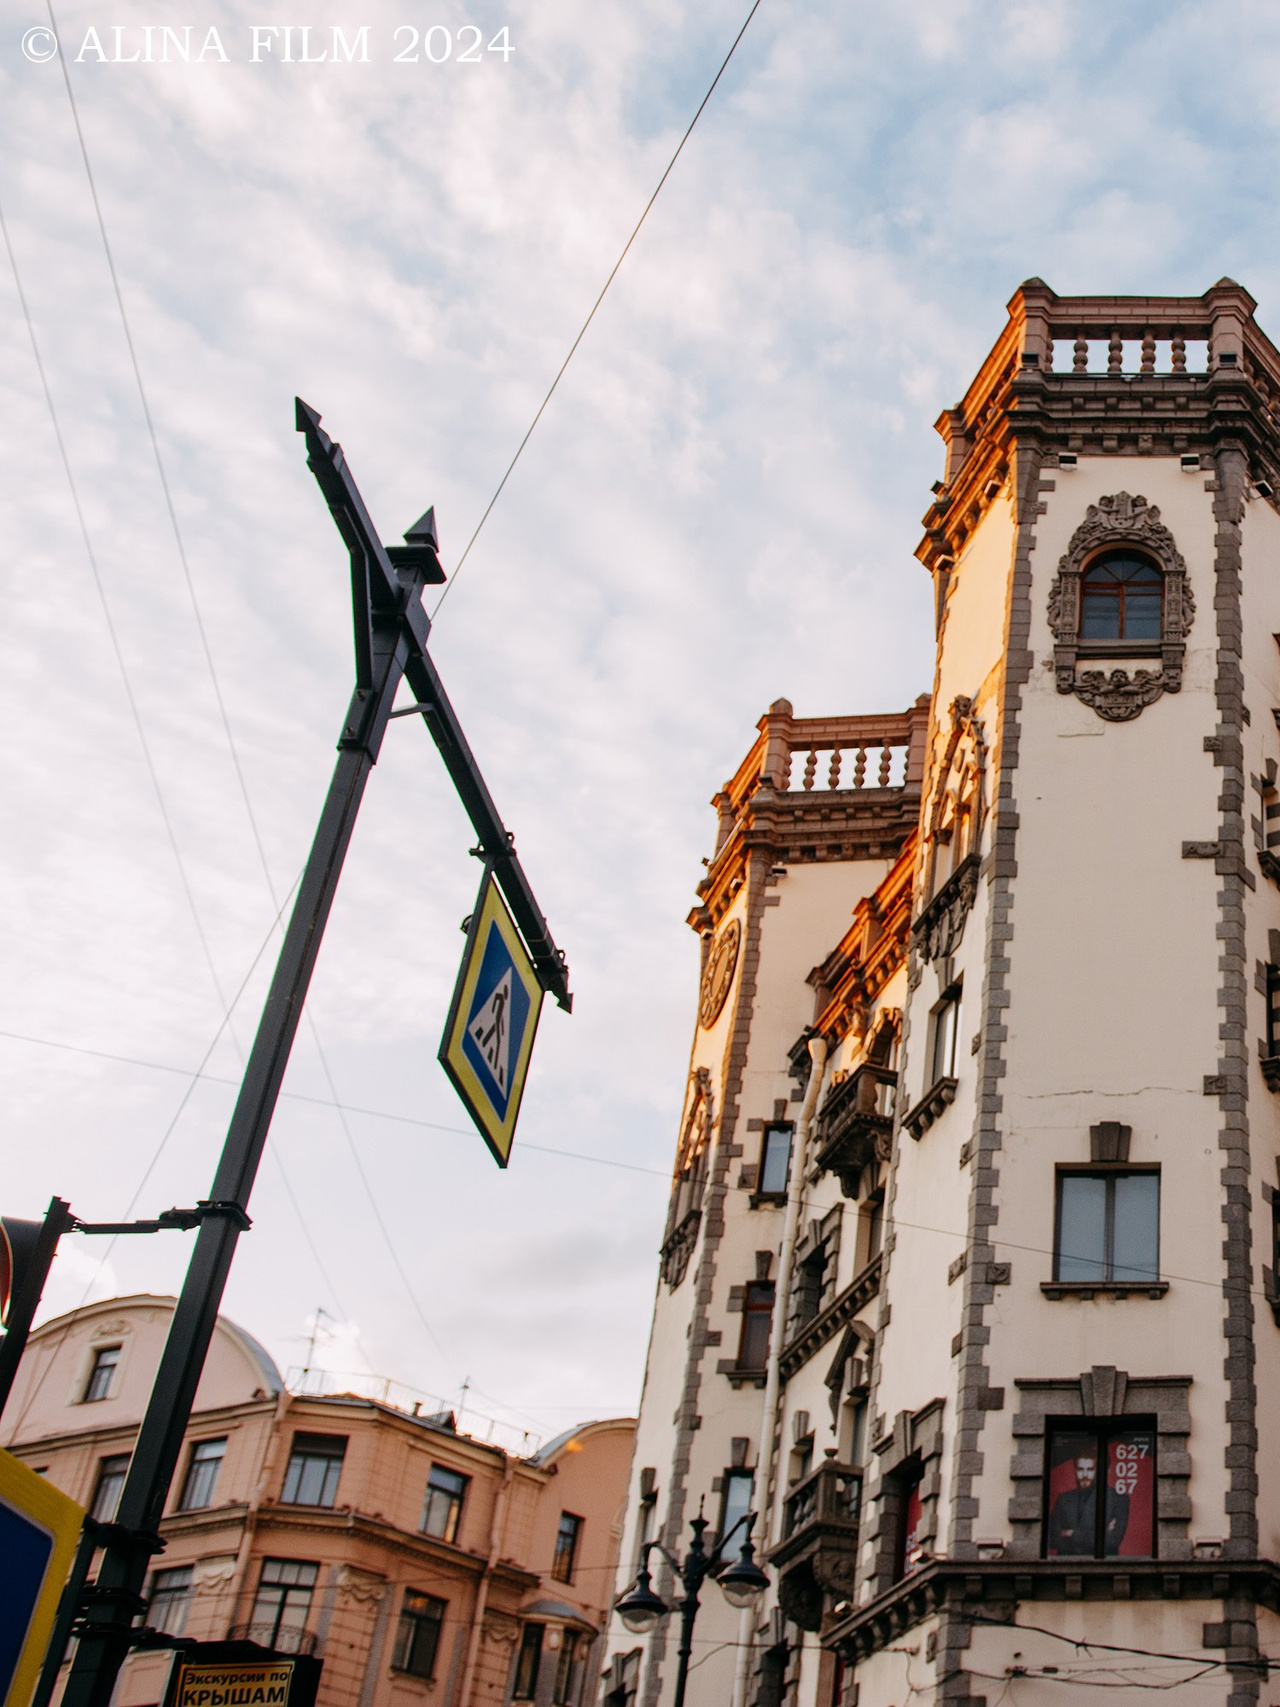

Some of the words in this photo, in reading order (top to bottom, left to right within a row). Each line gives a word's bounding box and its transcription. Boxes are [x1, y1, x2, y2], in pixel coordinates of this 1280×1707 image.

[1116, 1444, 1149, 1460] 627
[1115, 1461, 1138, 1478] 02
[1115, 1479, 1138, 1495] 67
[185, 1671, 266, 1686] Экскурсии
[269, 1671, 288, 1682] по
[183, 1686, 286, 1707] КРЫШАМ
